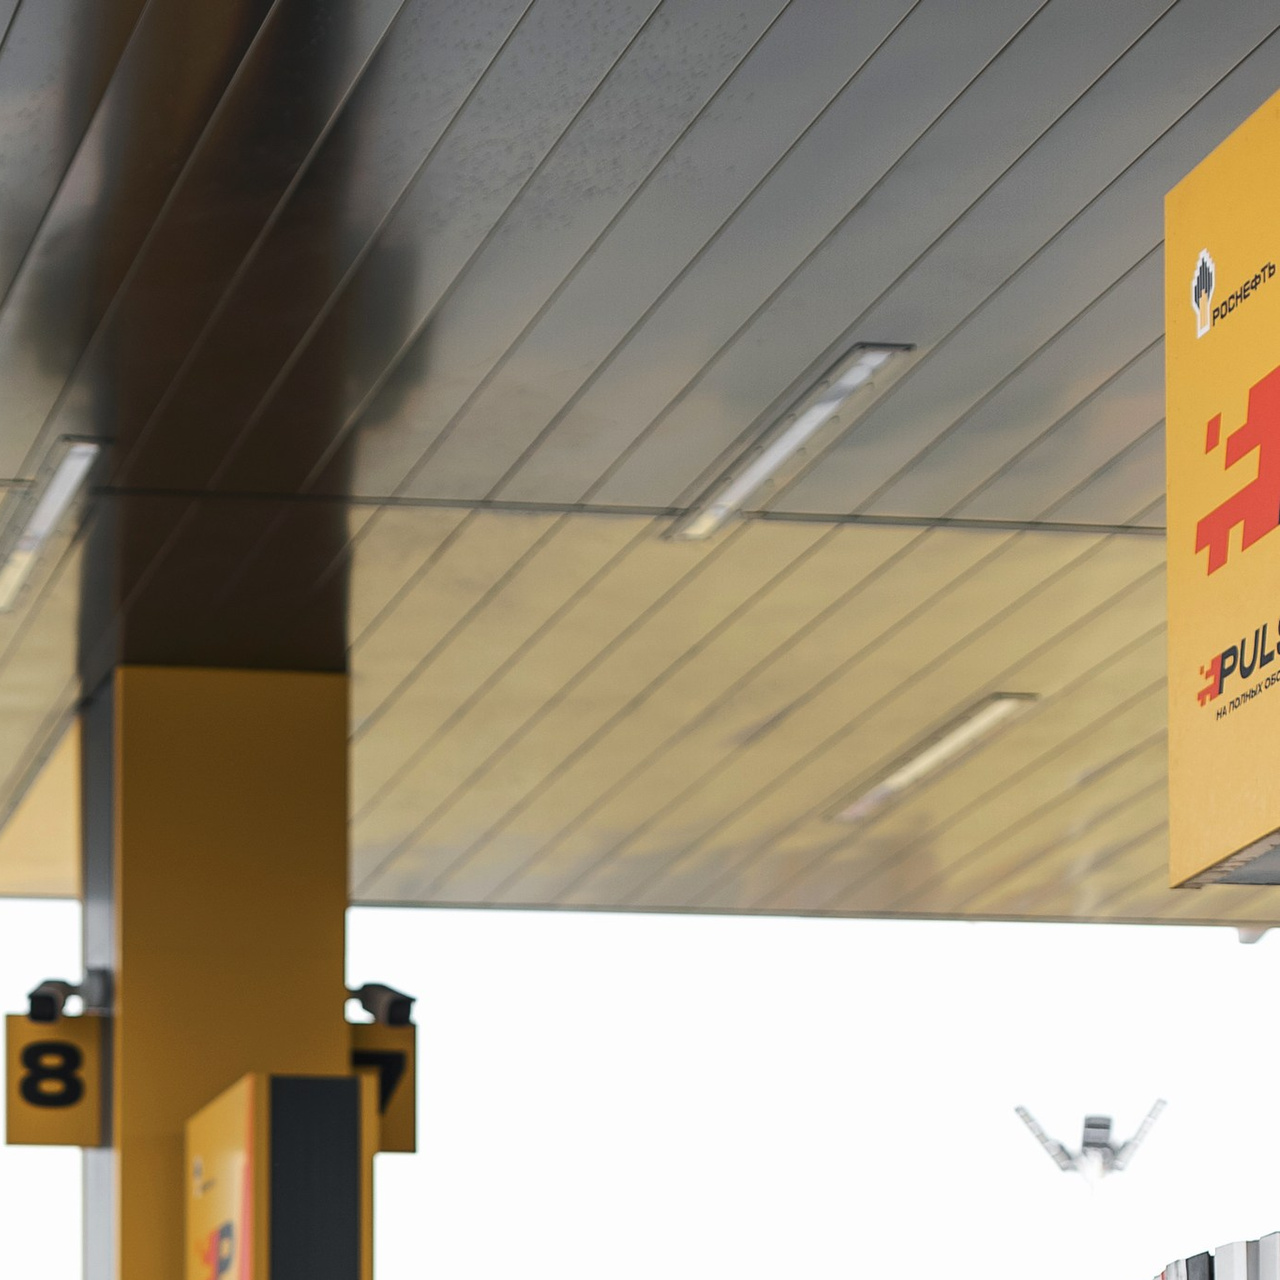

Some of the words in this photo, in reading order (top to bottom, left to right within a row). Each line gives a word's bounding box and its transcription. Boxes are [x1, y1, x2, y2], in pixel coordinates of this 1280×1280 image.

[1212, 262, 1276, 326] РОСНЕФТЬ
[1228, 682, 1263, 714] ПОЛНЫХ
[19, 1040, 86, 1109] 8
[350, 1049, 407, 1116] 7
